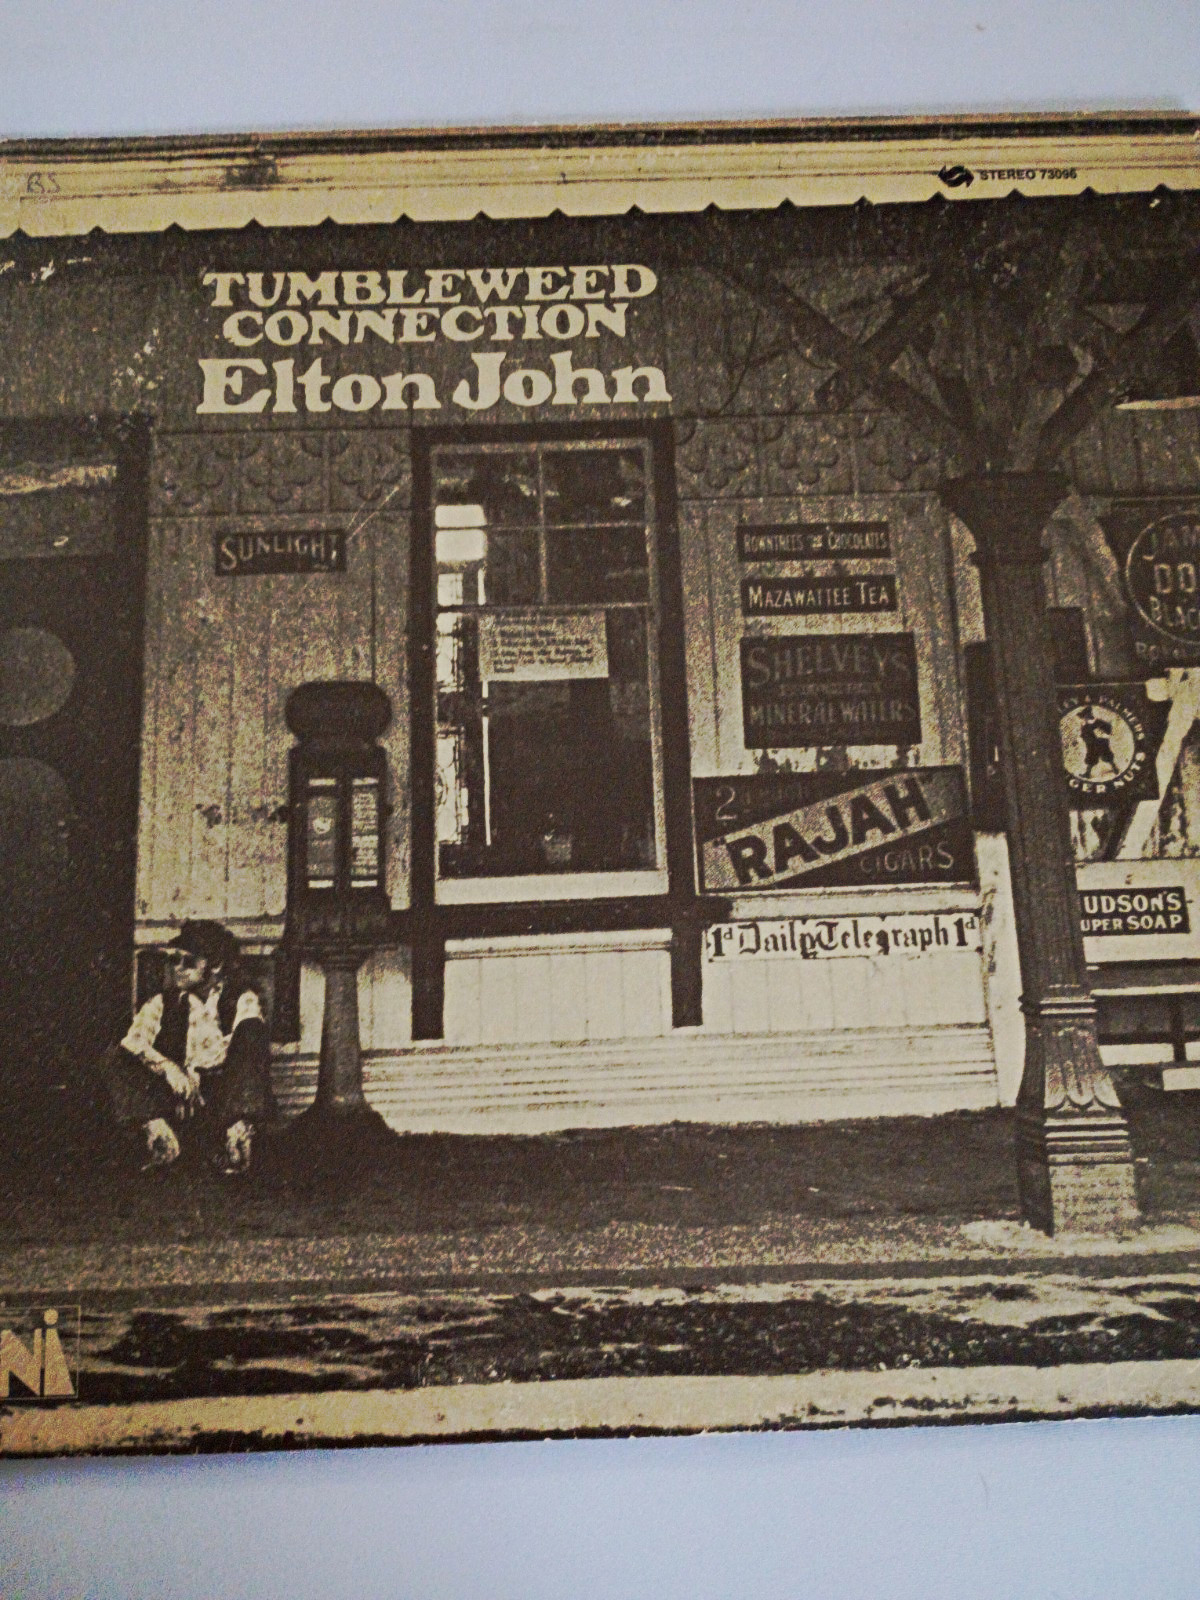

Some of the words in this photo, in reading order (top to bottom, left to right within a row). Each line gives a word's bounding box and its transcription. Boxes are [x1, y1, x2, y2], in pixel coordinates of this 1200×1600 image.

[980, 169, 1036, 180] STEREO
[1039, 168, 1077, 179] 73096
[202, 263, 658, 307] TUMBLEWEED
[222, 302, 630, 347] CONNECTION
[196, 356, 442, 414] Elton
[452, 350, 673, 410] John
[220, 534, 339, 570] SUNLIGHT
[748, 585, 851, 609] MAZAWATTEE
[855, 581, 890, 605] TEA
[1154, 563, 1197, 594] DO
[1148, 595, 1200, 630] BLAC
[860, 841, 955, 874] CIGARS
[1083, 891, 1182, 914] UDSON'S
[738, 918, 818, 960] Daily
[815, 916, 950, 956] Telegraph
[1080, 918, 1123, 932] UPER
[1126, 913, 1183, 931] SOAP
